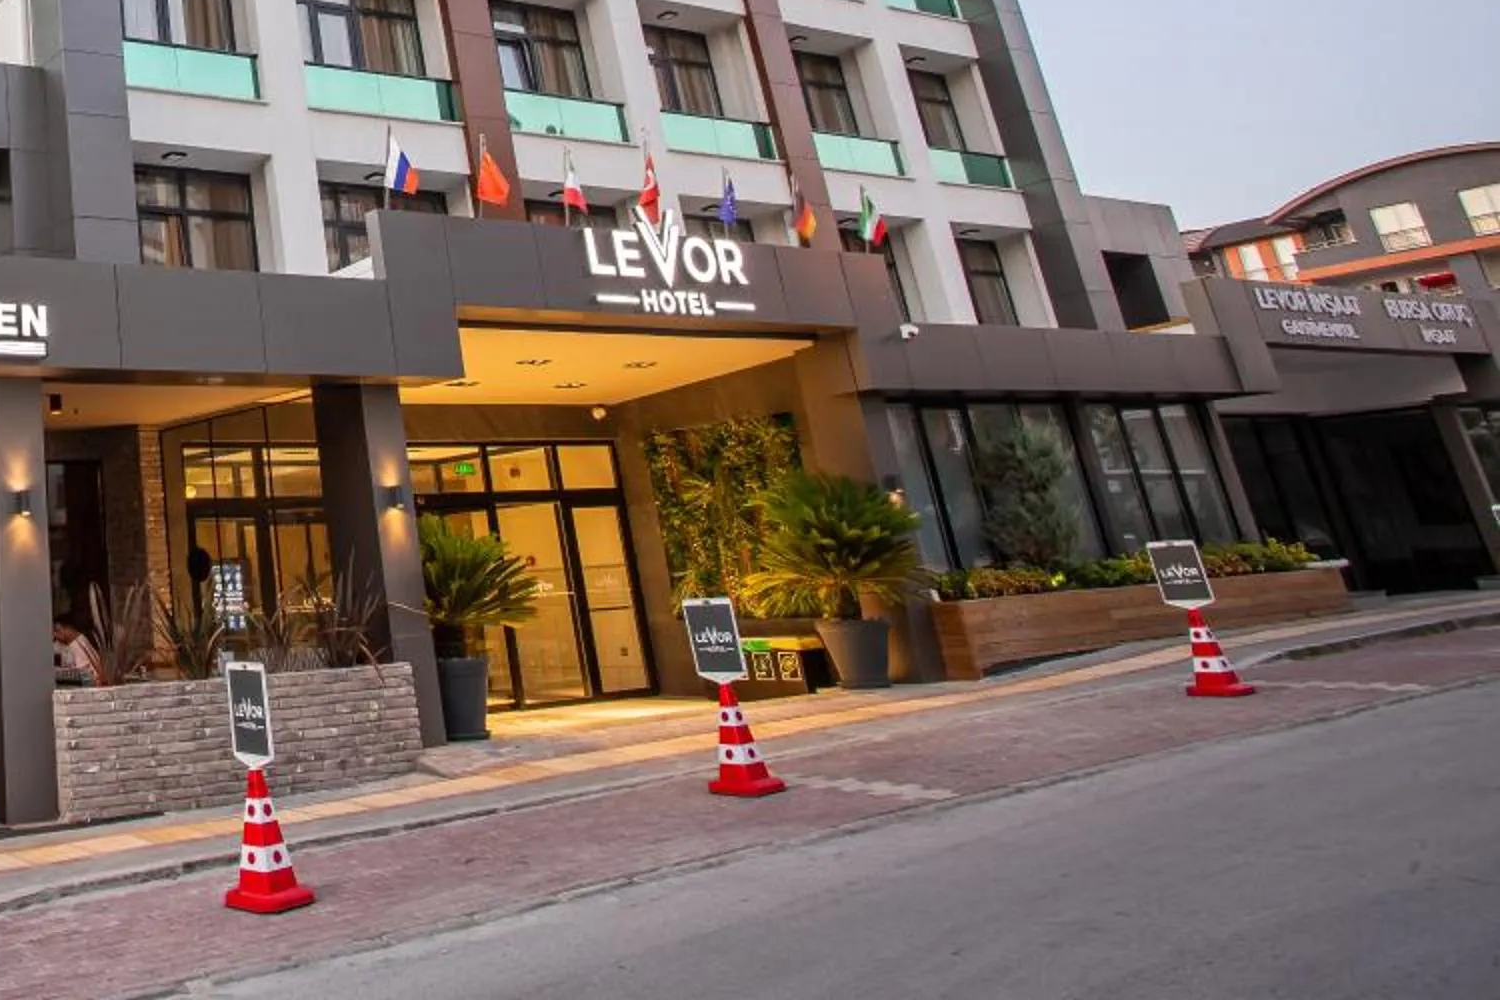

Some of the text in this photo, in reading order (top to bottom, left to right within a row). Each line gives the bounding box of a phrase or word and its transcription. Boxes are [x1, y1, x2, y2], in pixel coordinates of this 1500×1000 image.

[583, 206, 750, 287] LEVOR
[641, 289, 716, 316] HOTEL
[1253, 287, 1310, 312] LEVOR
[1382, 298, 1435, 321] BURSA
[695, 626, 733, 645] LEVOR
